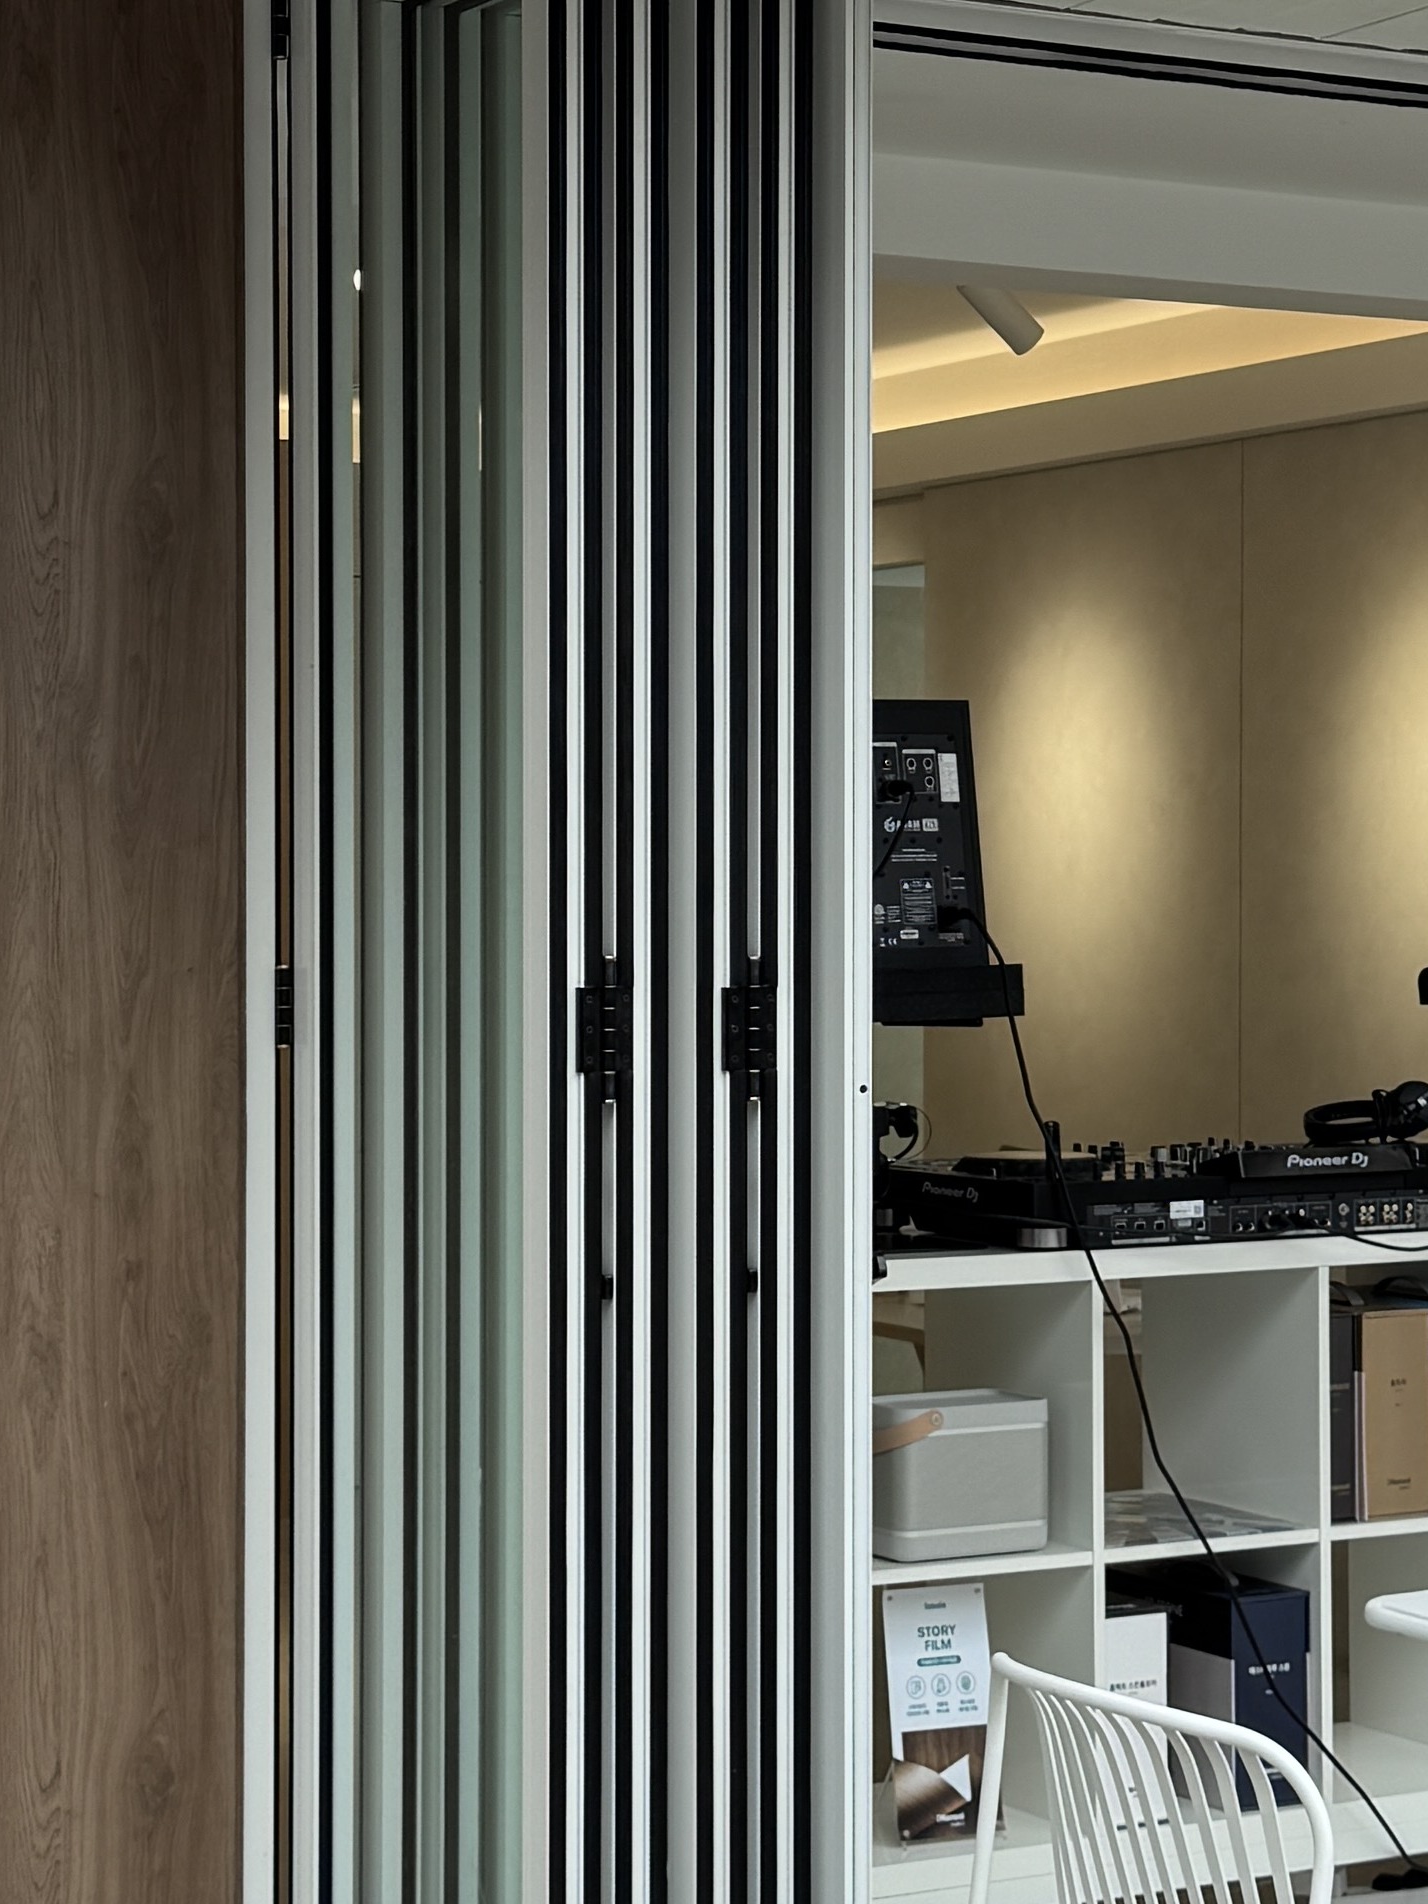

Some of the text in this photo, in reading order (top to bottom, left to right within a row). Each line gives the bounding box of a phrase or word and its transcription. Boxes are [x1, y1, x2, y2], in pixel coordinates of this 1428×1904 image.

[1286, 1154, 1349, 1168] Pioneer
[917, 1624, 956, 1638] STORY
[924, 1638, 952, 1651] FILM
